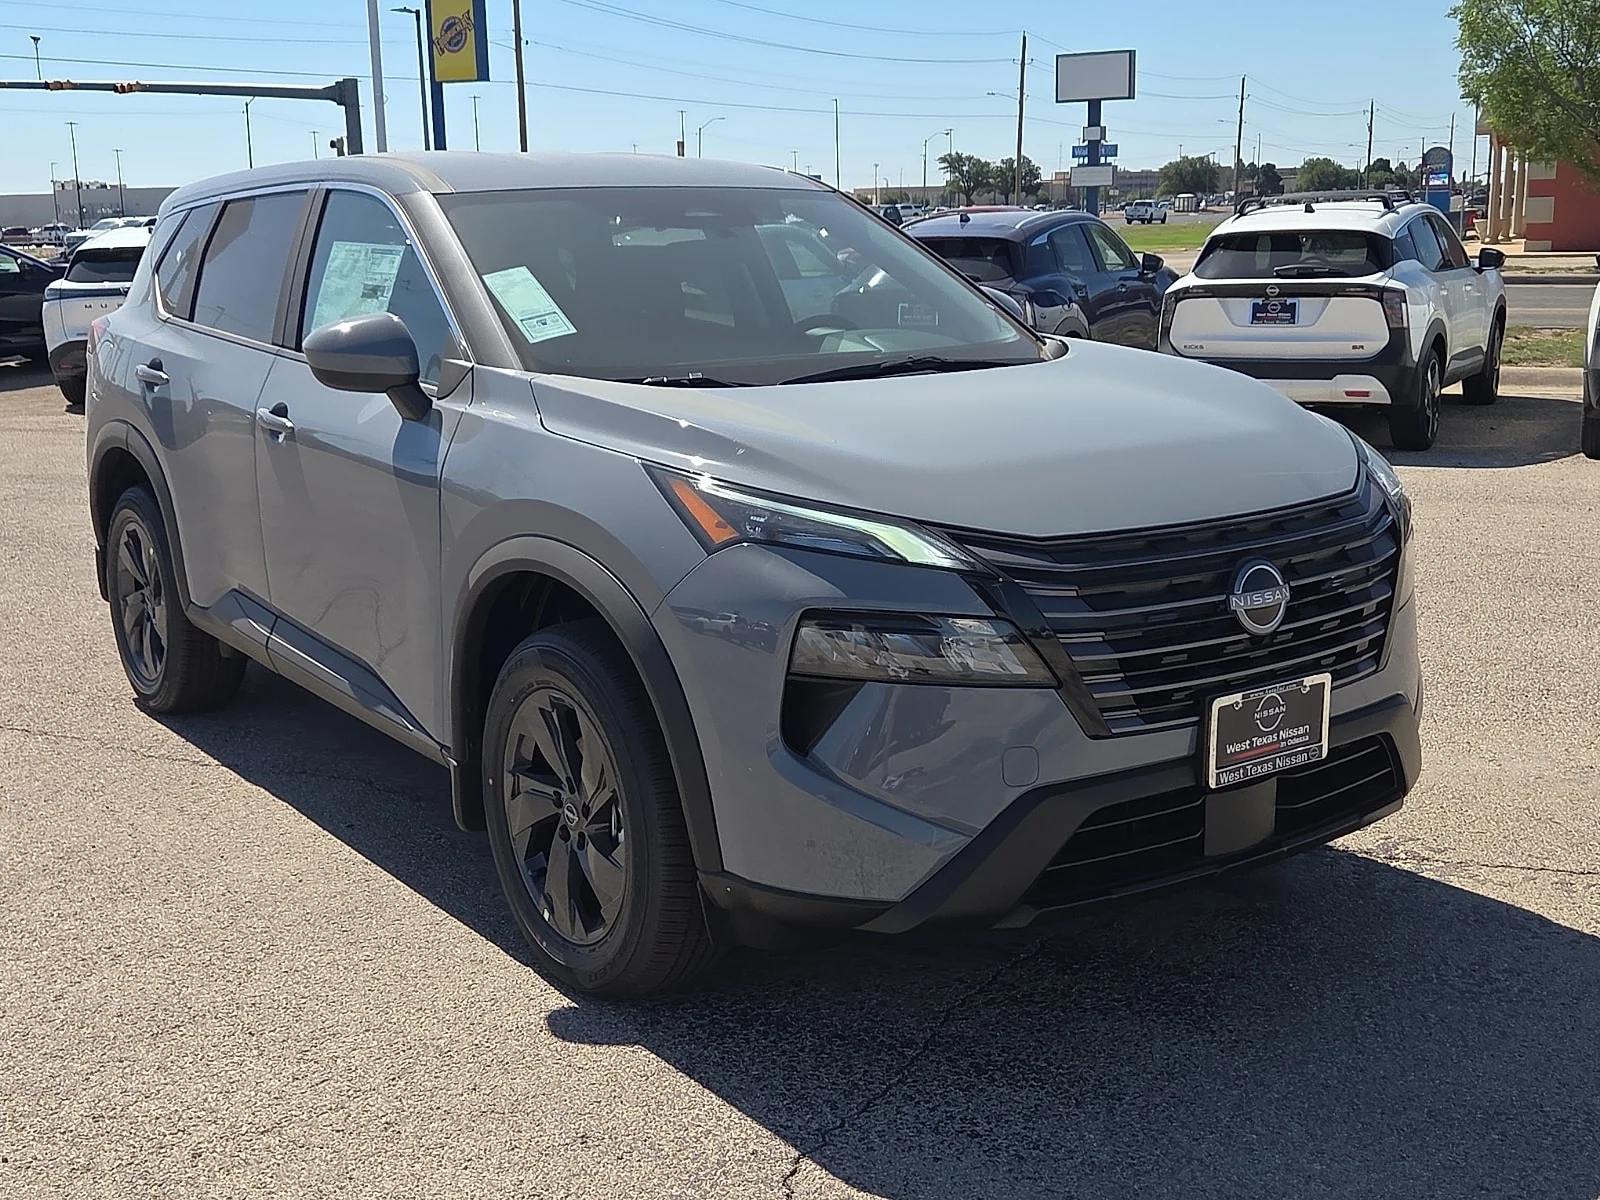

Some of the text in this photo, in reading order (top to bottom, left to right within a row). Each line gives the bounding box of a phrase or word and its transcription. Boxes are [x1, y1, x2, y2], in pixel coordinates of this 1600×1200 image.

[1232, 587, 1289, 607] NISSAN
[1254, 705, 1286, 720] NISSAN
[1226, 725, 1310, 754] West Texas Nissan
[1287, 735, 1309, 746] Odessa
[1219, 752, 1308, 784] West Texas Nissan
